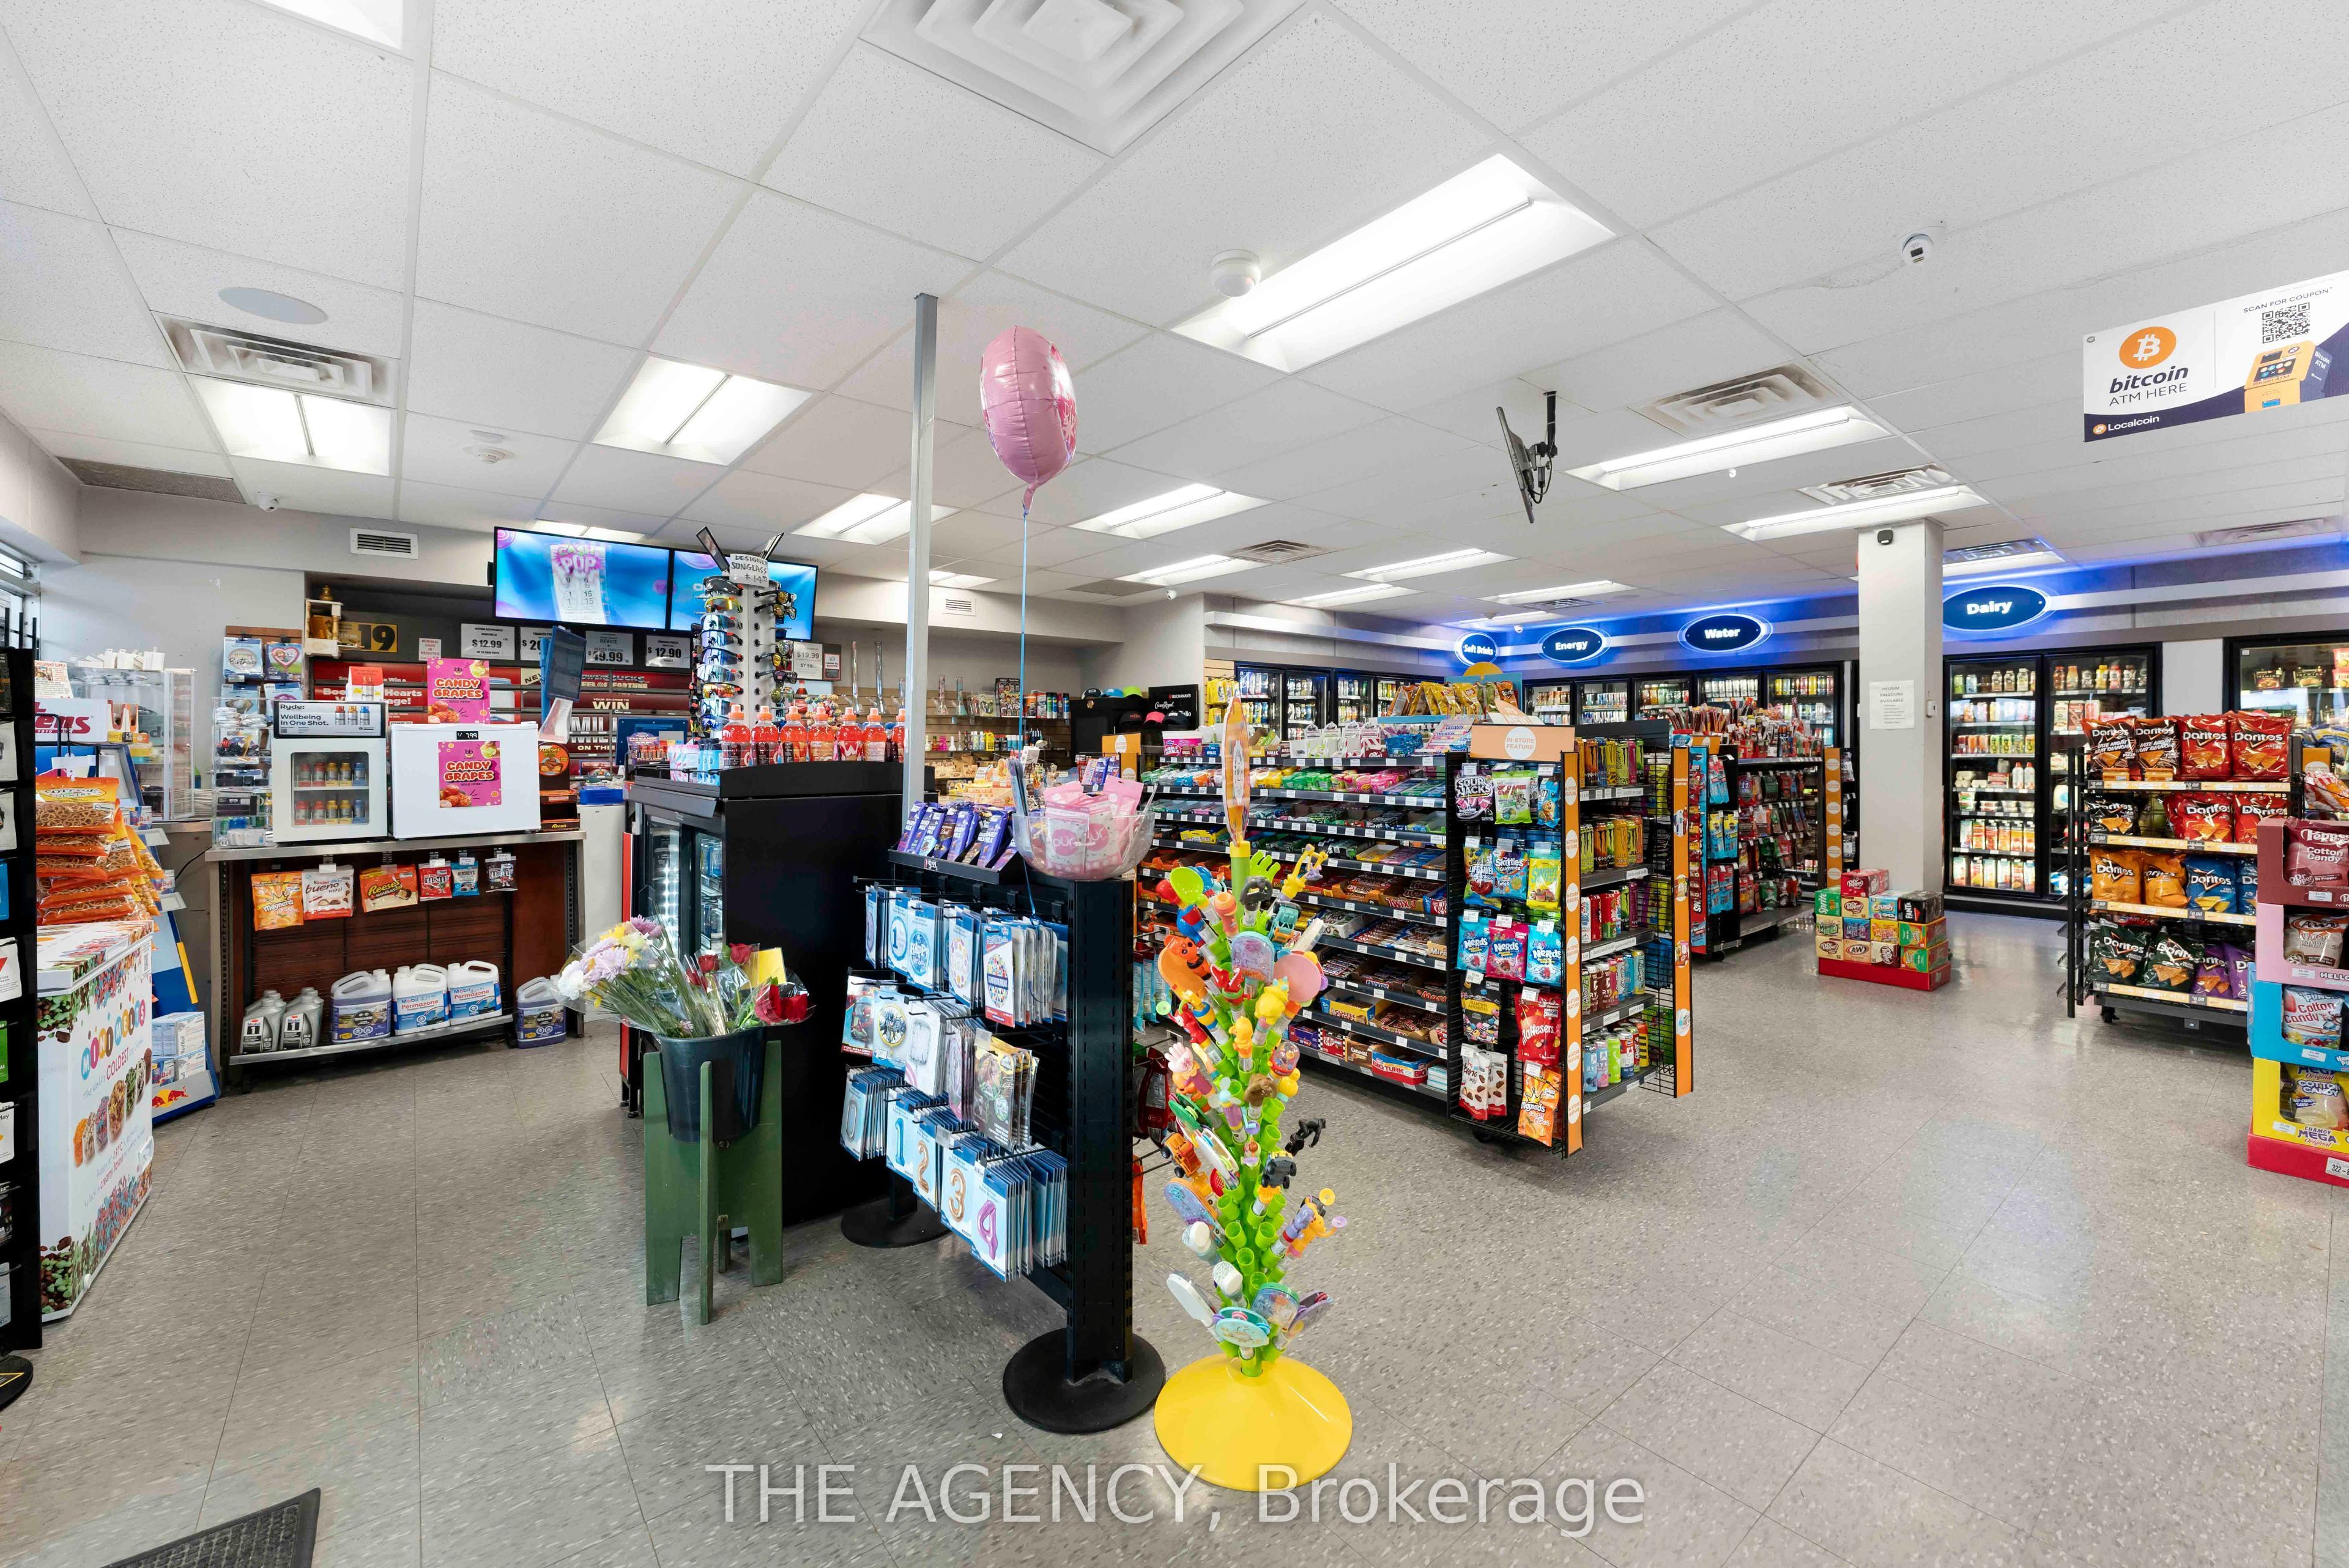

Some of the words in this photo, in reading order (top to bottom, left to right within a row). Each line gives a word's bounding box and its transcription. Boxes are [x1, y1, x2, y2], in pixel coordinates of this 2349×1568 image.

[2243, 303, 2268, 313] SCAN
[2269, 298, 2287, 308] FOR
[2314, 350, 2331, 364] Bitcoin
[2315, 360, 2326, 369] ATM
[2109, 366, 2188, 393] bitcoin
[2109, 391, 2140, 407] ATM
[2147, 382, 2187, 401] HERE
[2108, 415, 2160, 432] Localcoin
[558, 544, 596, 557] CASH
[560, 554, 597, 573] POP
[1966, 599, 2013, 615] Dairy
[358, 624, 396, 651] 19
[1704, 626, 1740, 639] Water
[472, 639, 502, 648] $12.99
[1464, 642, 1477, 654] Soft
[1477, 644, 1494, 656] Drinks
[1555, 638, 1588, 653] Energy
[435, 679, 481, 689] CANDY
[385, 689, 422, 697] Hearts
[432, 689, 484, 698] GRAPES
[592, 701, 629, 710] WIN
[2092, 728, 2129, 737] Doritos
[2183, 732, 2227, 741] Doritos
[2235, 732, 2283, 741] Doritos
[447, 761, 491, 771] CANDY
[444, 771, 494, 782] GRAPES
[1458, 777, 1487, 785] SOUR
[1460, 784, 1491, 795] JACKS
[2186, 805, 2231, 814] Doritos
[2307, 847, 2343, 856] Cotton
[1496, 857, 1524, 867] Skittles
[2307, 854, 2342, 864] Candy
[2096, 865, 2134, 876] Doritos
[2191, 875, 2231, 885] Doritos
[306, 882, 339, 893] bueno
[1819, 892, 1827, 914] Sprite
[2104, 937, 2144, 953] Doritos
[454, 989, 489, 999] Permazone
[401, 999, 439, 1009] Permazone
[2298, 1002, 2334, 1013] Cotton
[2285, 1012, 2319, 1024] Candy
[81, 1027, 114, 1080] MINI
[115, 999, 146, 1046] MELTS
[1521, 1024, 1554, 1045] Maltesers
[106, 1047, 128, 1080] COLDEST
[1373, 1061, 1384, 1070] BIG
[1384, 1066, 1405, 1074] TURK
[2298, 1079, 2342, 1090] COTTON
[2303, 1086, 2339, 1096] CANDY
[1521, 1101, 1546, 1113] Maynards
[2305, 1126, 2331, 1134] CHAMOY
[2298, 1130, 2337, 1144] MEGA
[2304, 1138, 2331, 1147] Original
